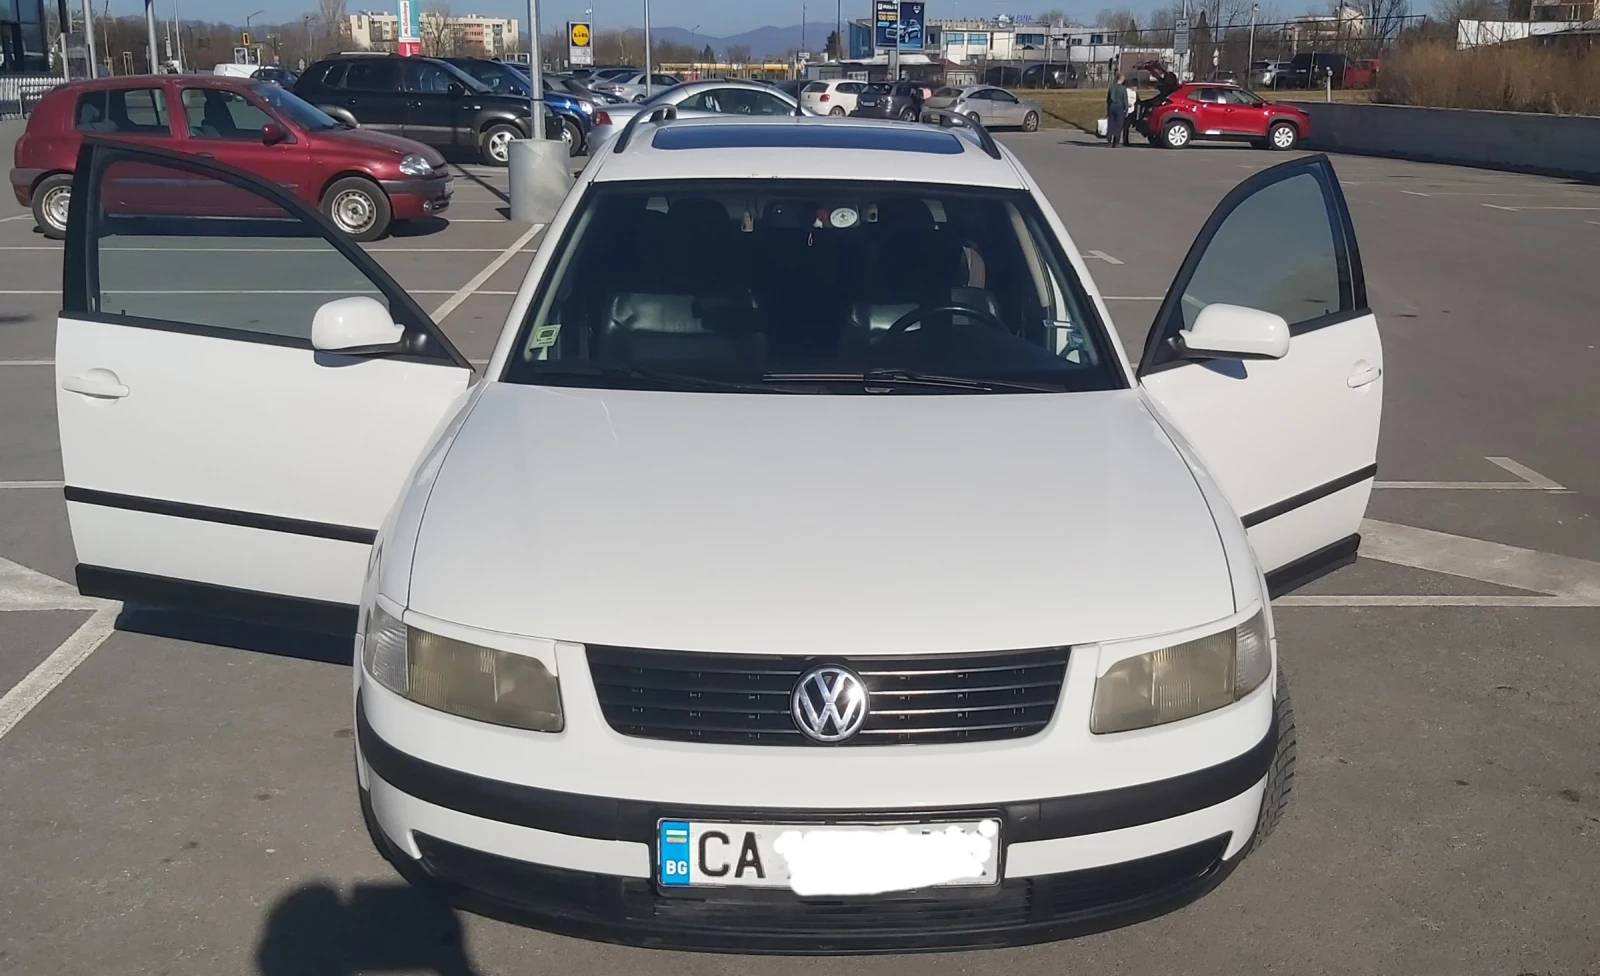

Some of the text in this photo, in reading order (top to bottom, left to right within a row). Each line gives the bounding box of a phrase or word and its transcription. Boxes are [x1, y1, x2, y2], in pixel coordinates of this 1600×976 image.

[794, 668, 865, 741] VW
[666, 860, 688, 875] BG
[698, 830, 767, 878] CA
